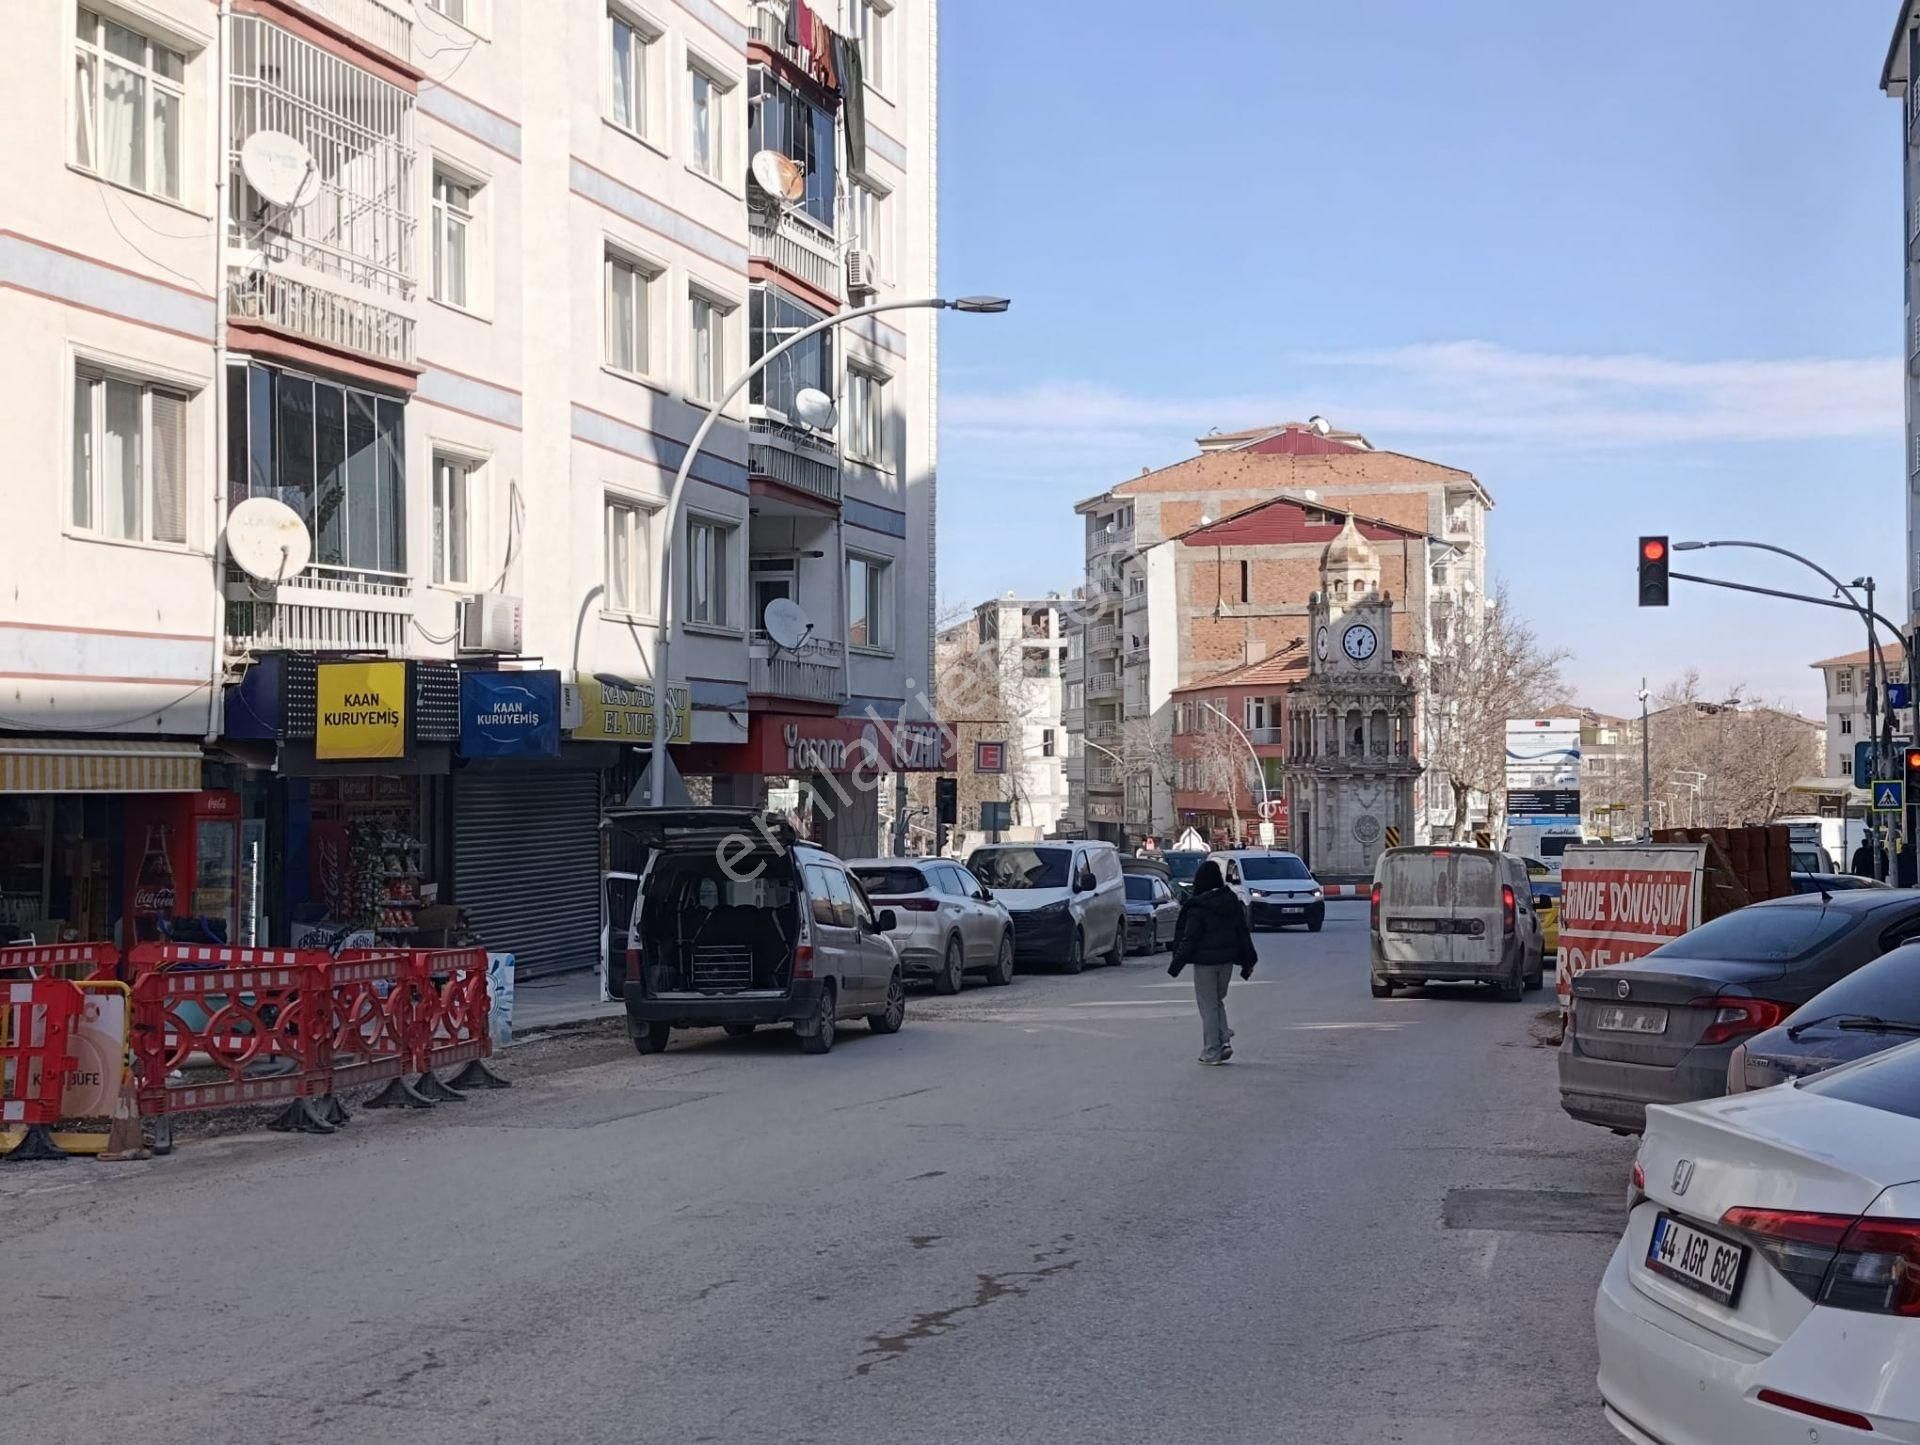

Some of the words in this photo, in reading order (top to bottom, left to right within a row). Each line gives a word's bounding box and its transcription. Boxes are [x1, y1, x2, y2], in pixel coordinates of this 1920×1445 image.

[344, 693, 379, 706] KAAN
[493, 703, 523, 713] KAAN
[324, 708, 399, 728] KURUYEMİŞ
[477, 712, 539, 726] KURUYEMİŞ
[604, 711, 621, 734] EL
[1610, 874, 1687, 935] DÖNÜŞÜM
[1661, 1224, 1678, 1263] 44
[1680, 1233, 1709, 1277] AGR
[1711, 1246, 1739, 1292] 682
